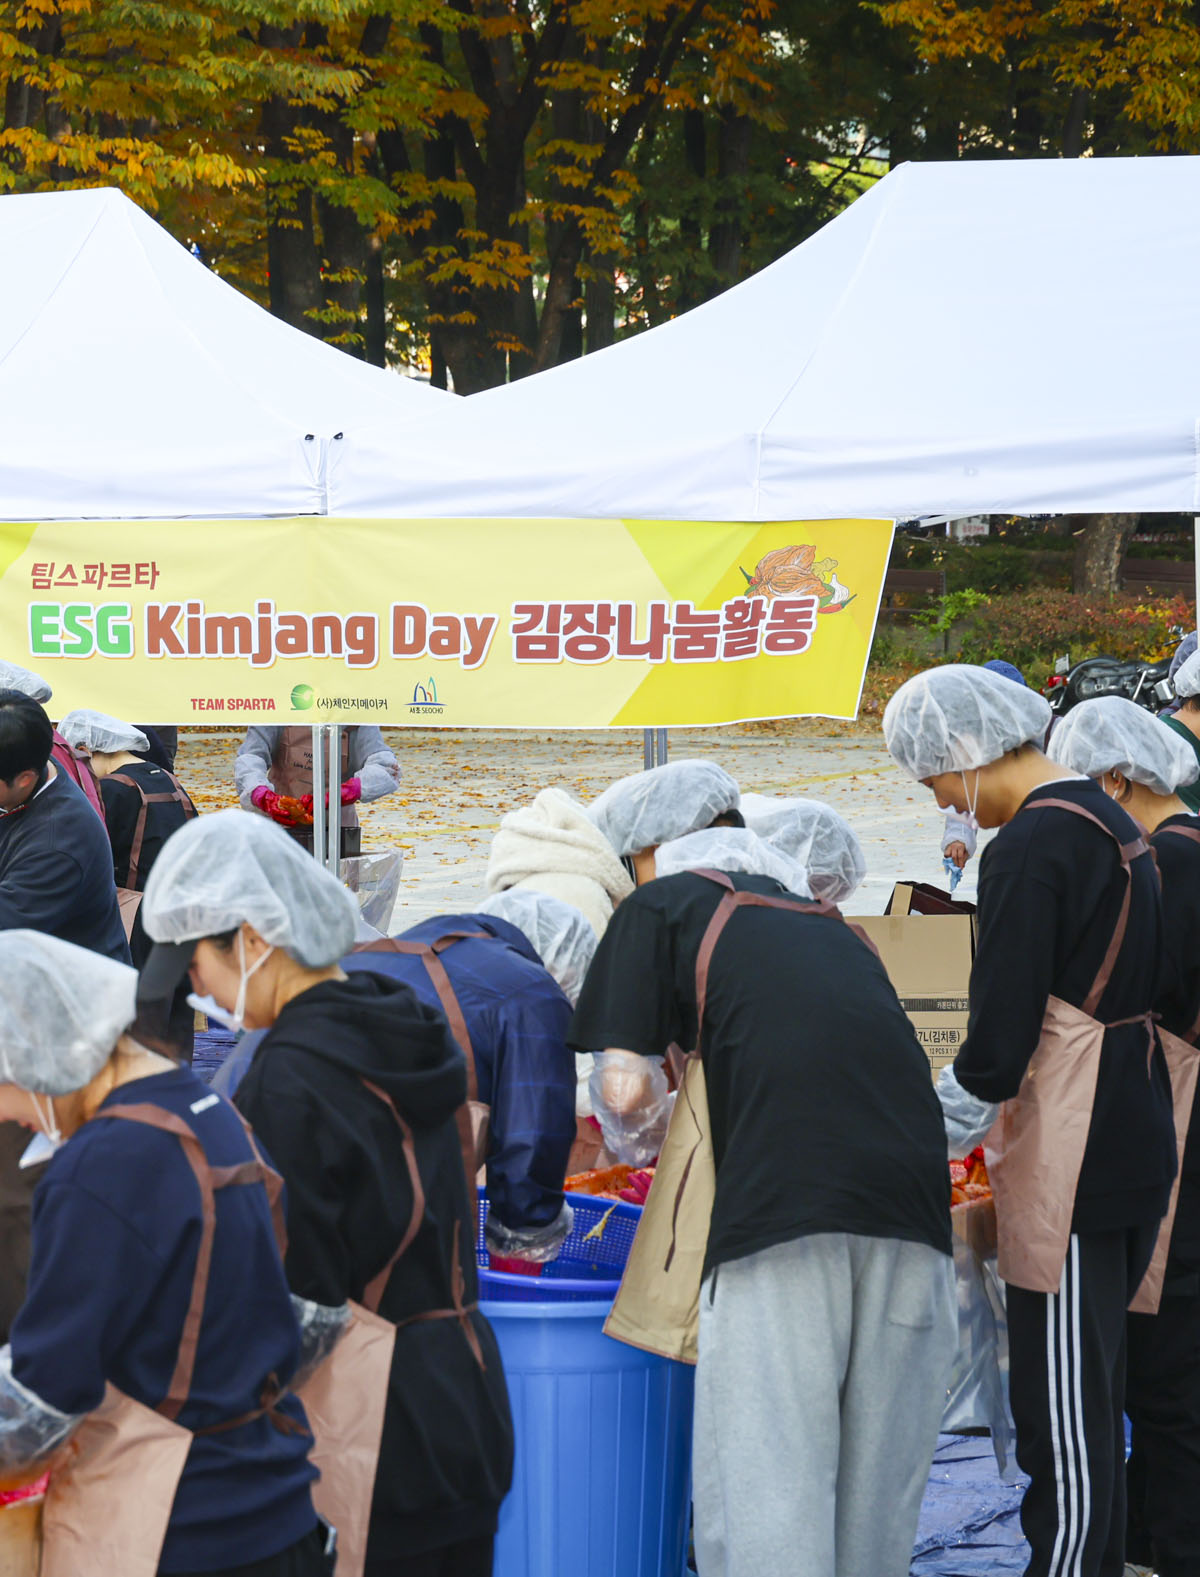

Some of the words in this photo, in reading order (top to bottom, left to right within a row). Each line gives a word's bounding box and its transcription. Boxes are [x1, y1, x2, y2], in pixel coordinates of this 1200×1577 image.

[31, 561, 160, 590] 팀스파르타
[29, 602, 133, 658] ESG
[145, 601, 379, 666] Kimjang
[392, 603, 497, 667] Day
[511, 597, 816, 661] 김장나눔활동
[190, 698, 225, 711] TEAM
[227, 698, 276, 711] SPARTA
[316, 697, 388, 711] (사)체인지메이커
[421, 707, 444, 715] SEOCHO
[915, 1030, 961, 1044] 7L(김치통)
